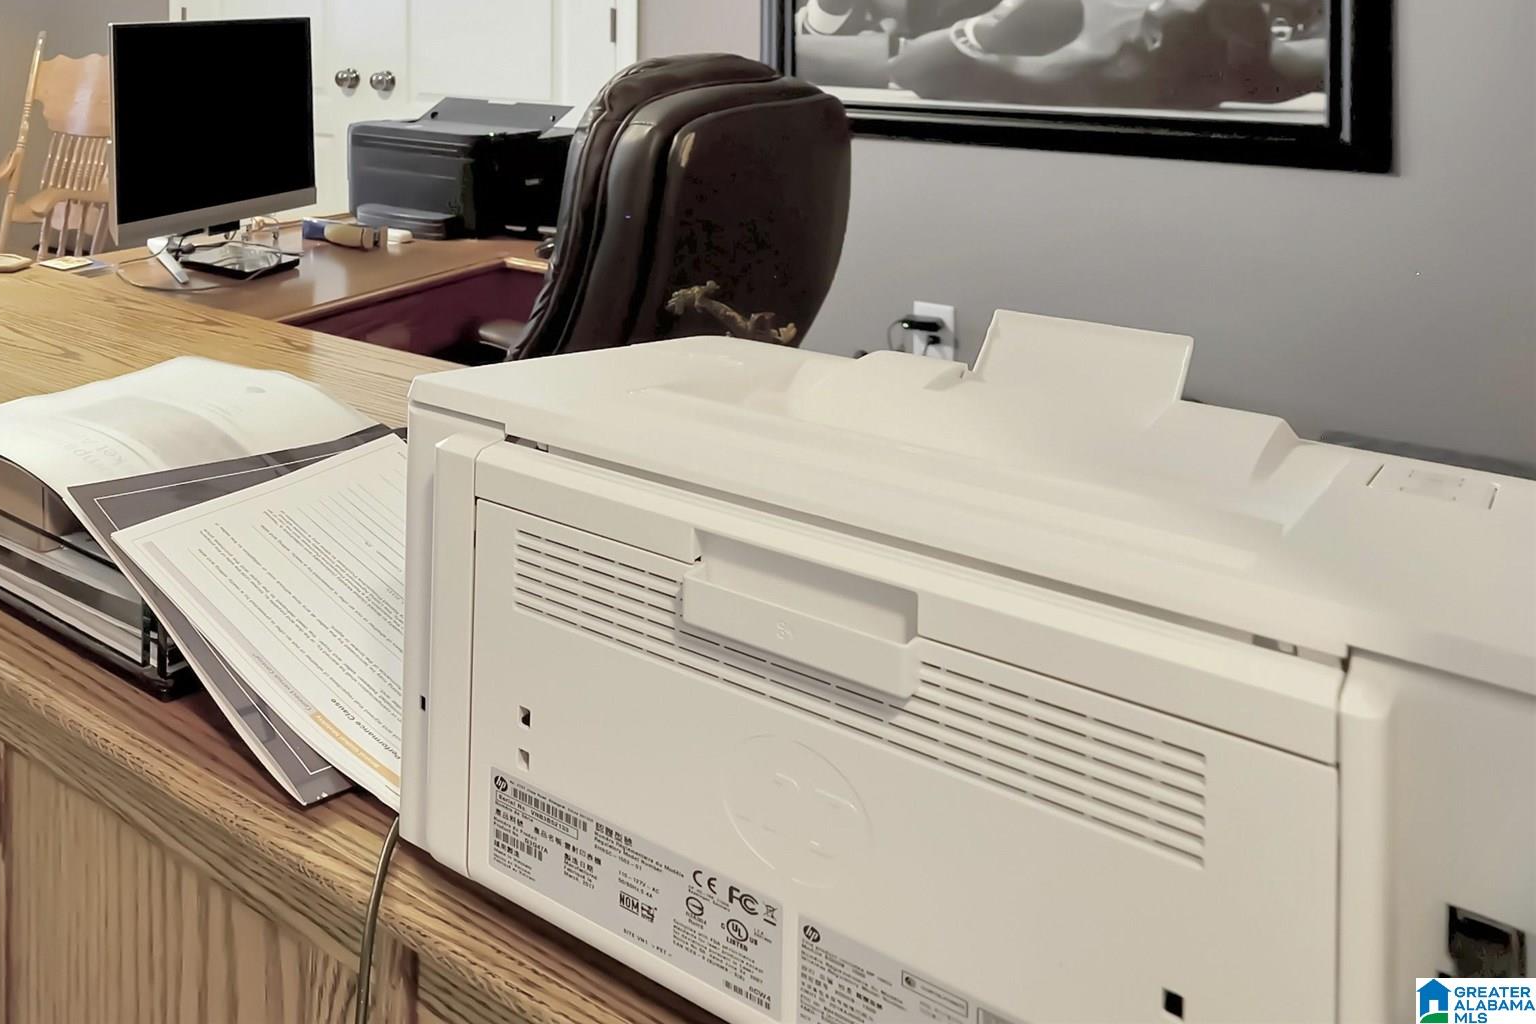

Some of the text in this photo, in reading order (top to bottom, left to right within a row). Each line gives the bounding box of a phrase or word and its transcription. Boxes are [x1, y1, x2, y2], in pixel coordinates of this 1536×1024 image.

[330, 697, 355, 721] Clause
[498, 794, 515, 807] Serial
[692, 867, 716, 895] CE
[619, 892, 639, 913] NOM
[803, 924, 821, 943] hp
